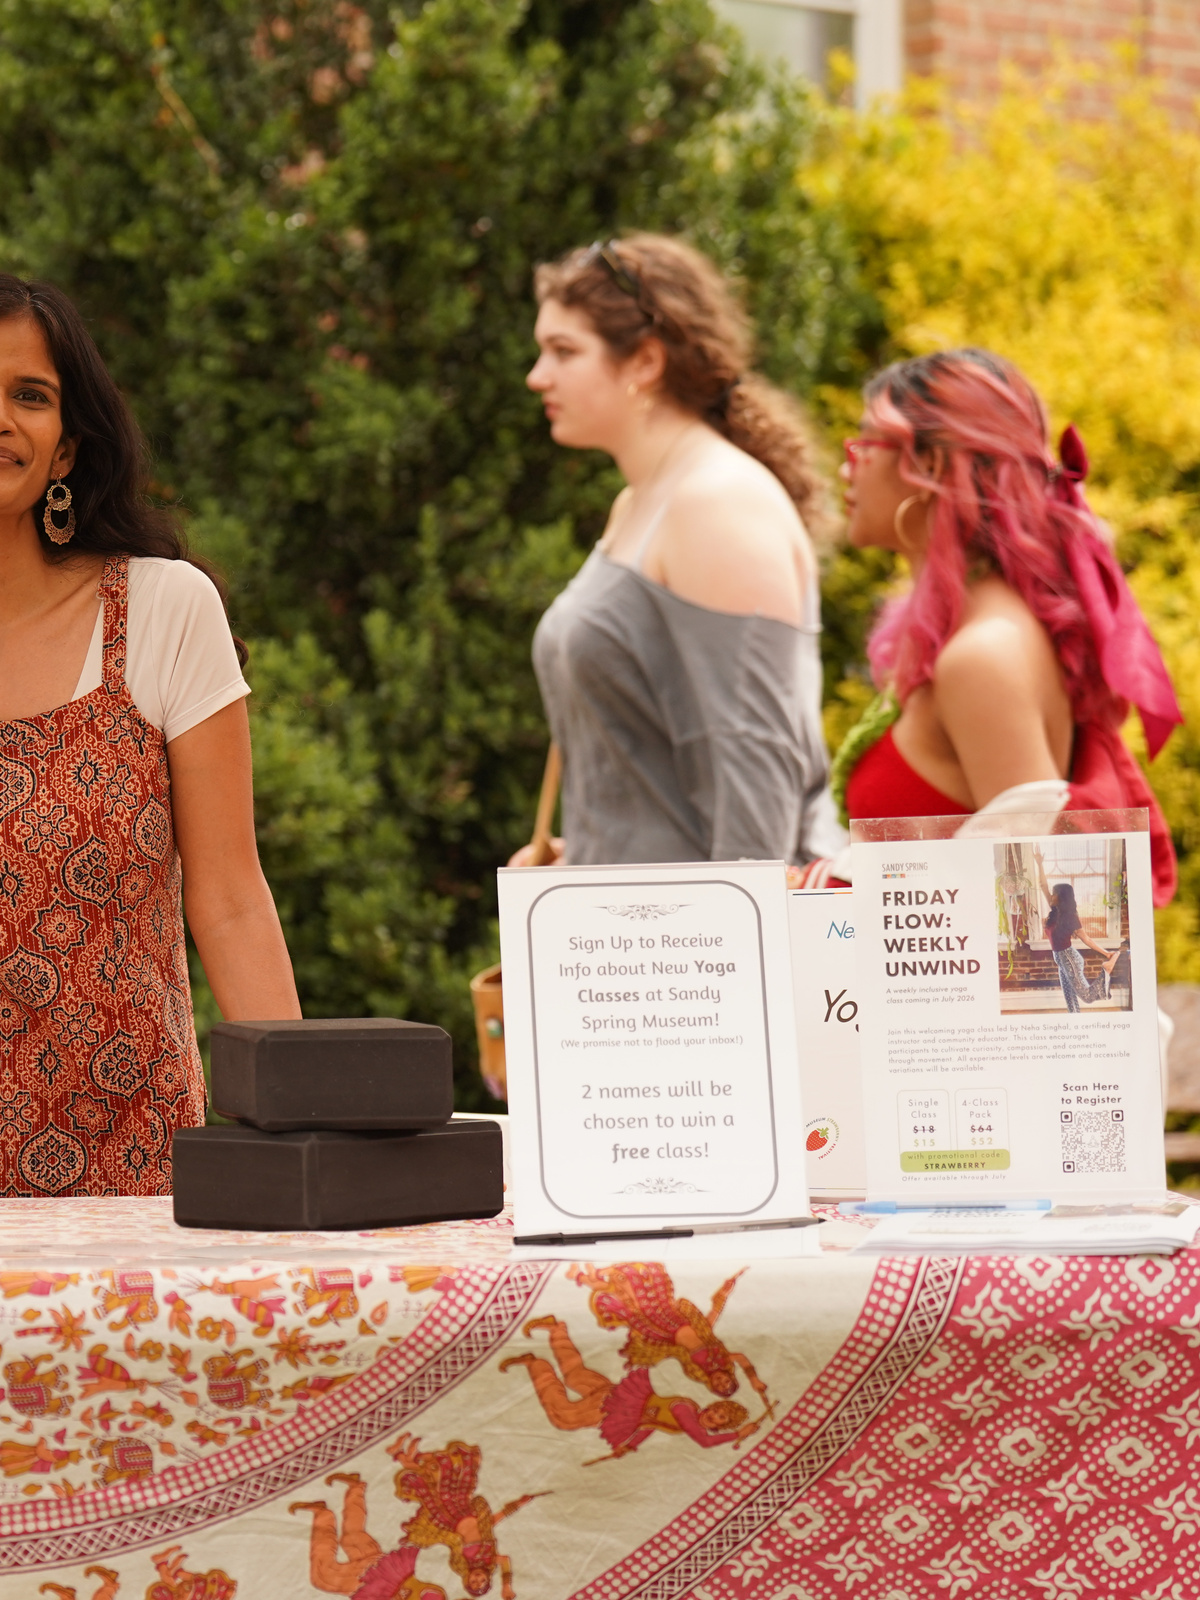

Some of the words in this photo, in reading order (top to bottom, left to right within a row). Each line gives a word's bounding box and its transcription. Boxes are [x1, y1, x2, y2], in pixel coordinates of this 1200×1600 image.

[881, 862, 904, 872] SANDY
[905, 862, 928, 871] SPRING
[882, 889, 959, 906] FRIDAY
[883, 913, 951, 930] FLOW:
[827, 920, 855, 939] Ne
[569, 936, 604, 954] Sign
[610, 936, 633, 953] Up
[638, 936, 655, 948] to
[661, 933, 722, 948] Receive
[883, 935, 968, 953] WEEKLY
[559, 962, 591, 980] Info
[597, 961, 646, 976] about
[652, 961, 688, 974] New
[693, 960, 736, 977] Yoga
[885, 959, 980, 977] UNWIND
[577, 988, 640, 1003] Classes
[645, 989, 663, 1001] at
[668, 985, 721, 1003] Sandy
[824, 989, 859, 1033] Yo
[582, 1014, 636, 1033] Spring
[642, 1012, 719, 1028] Museum!
[918, 1027, 955, 1035] welcoming
[1009, 1024, 1018, 1033] by
[1080, 1022, 1110, 1030] certified
[560, 1039, 580, 1049] (We
[582, 1038, 621, 1049] promise
[623, 1038, 640, 1046] not
[642, 1038, 653, 1046] to
[655, 1036, 680, 1048] flood
[683, 1038, 706, 1047] your
[708, 1035, 743, 1045] inbox!)
[922, 1036, 936, 1044] and
[888, 1056, 915, 1064] through
[1094, 1050, 1130, 1058] accessible
[582, 1084, 592, 1099] 2
[598, 1086, 661, 1099] names
[668, 1080, 704, 1097] will
[710, 1080, 732, 1096] be
[1062, 1083, 1088, 1091] Scan
[1092, 1082, 1119, 1090] Here
[908, 1098, 938, 1108] Single
[961, 1098, 998, 1106] 4-Class
[1076, 1095, 1122, 1106] Register
[583, 1113, 648, 1129] chosen
[655, 1114, 674, 1128] to
[681, 1111, 716, 1127] win
[723, 1114, 734, 1126] a
[969, 1110, 992, 1118] Pack
[805, 1117, 826, 1128] MUSEUM
[913, 1125, 935, 1134] $18
[970, 1124, 993, 1133] $64
[914, 1138, 935, 1147] $15
[611, 1143, 650, 1163] free
[656, 1142, 708, 1158] class!
[927, 1150, 977, 1161] promotional
[980, 1150, 1004, 1158] code:
[924, 1162, 985, 1170] STRAWBERRY
